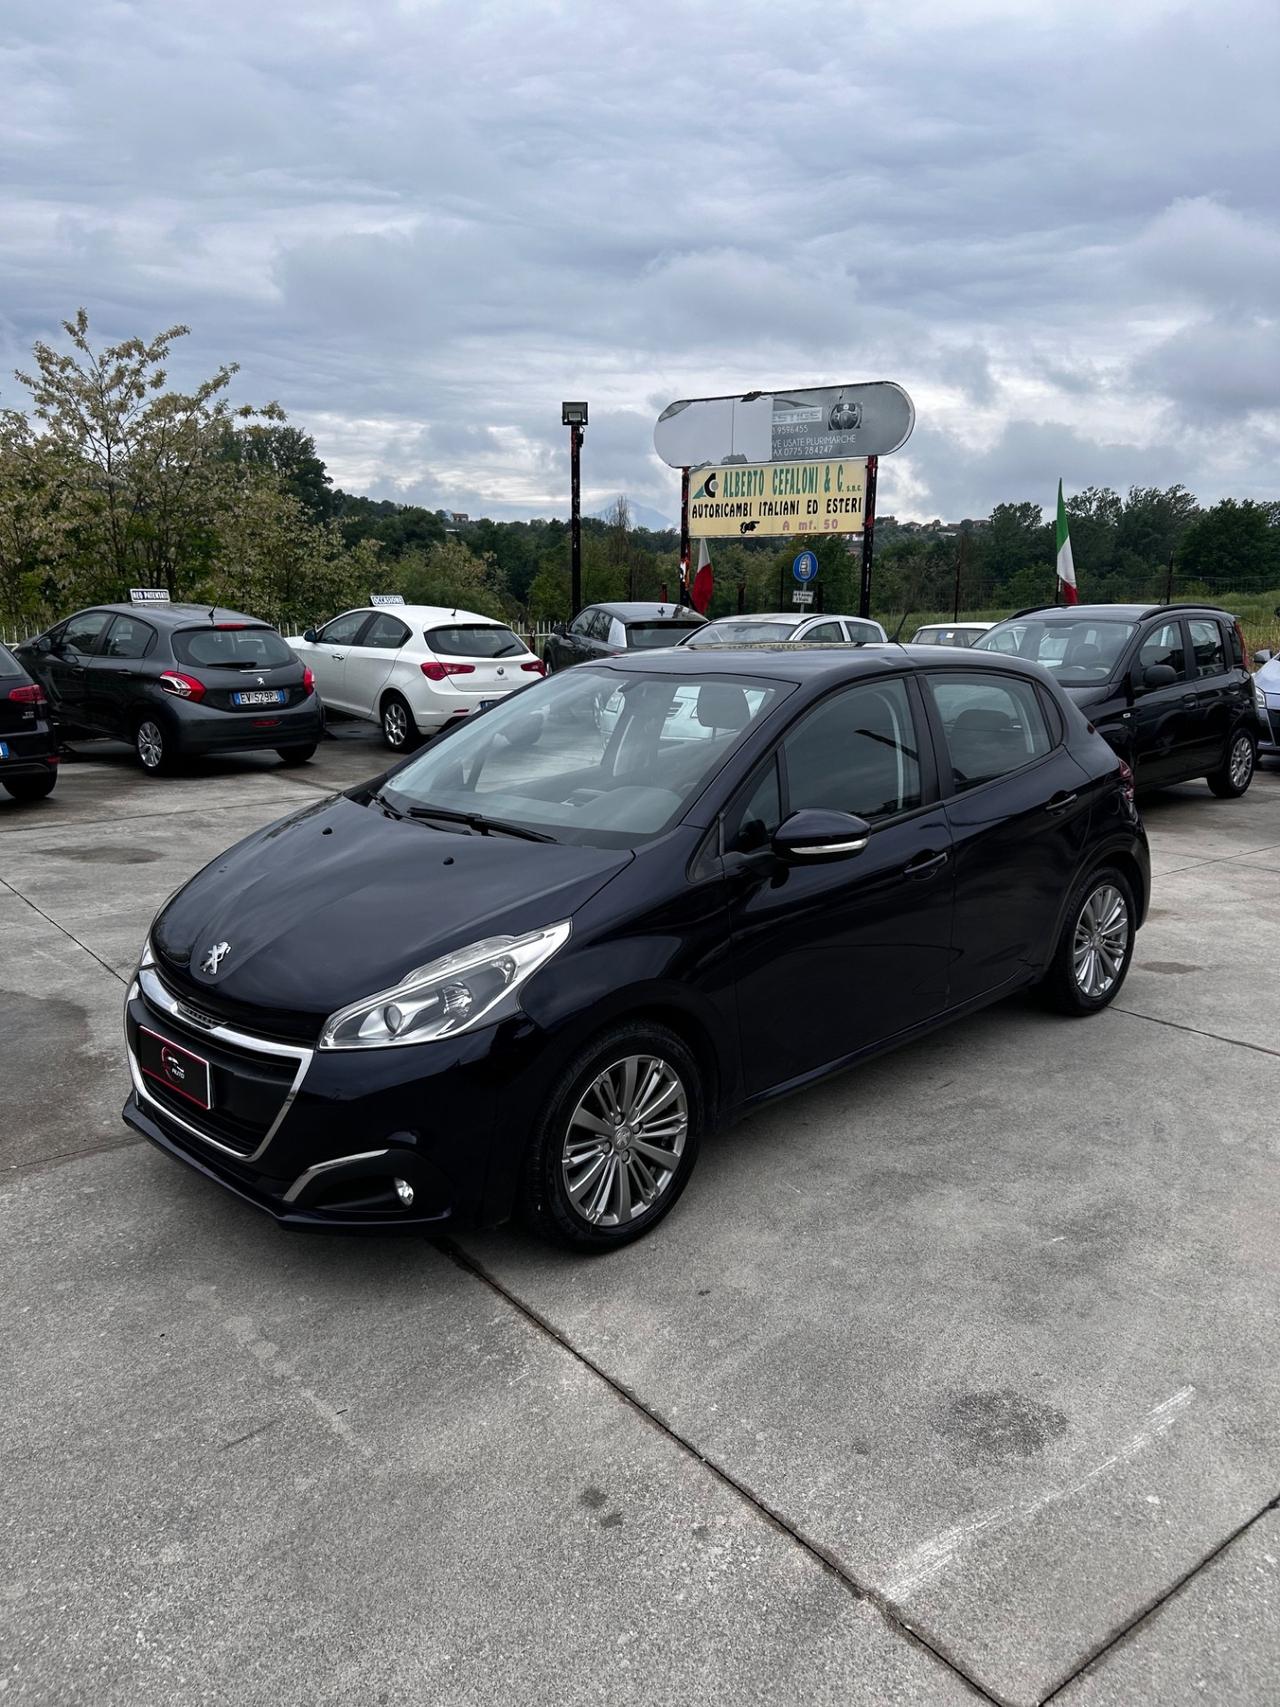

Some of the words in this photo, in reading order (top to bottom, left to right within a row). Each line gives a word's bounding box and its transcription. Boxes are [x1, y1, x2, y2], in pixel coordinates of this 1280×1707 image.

[783, 438, 805, 447] USATE
[807, 434, 856, 446] PLURIMARCHE
[784, 446, 803, 456] 0775
[804, 445, 833, 455] 284247
[723, 469, 764, 498] ALBERTO
[773, 466, 818, 496] CEFALONI
[824, 465, 831, 494] &
[692, 502, 752, 519] AUTORICAMBI
[758, 500, 799, 517] ITALIANI
[806, 500, 819, 515] ED
[826, 497, 862, 514] ESTERI
[783, 520, 790, 531] A
[823, 519, 838, 529] 50
[241, 693, 252, 703] EV
